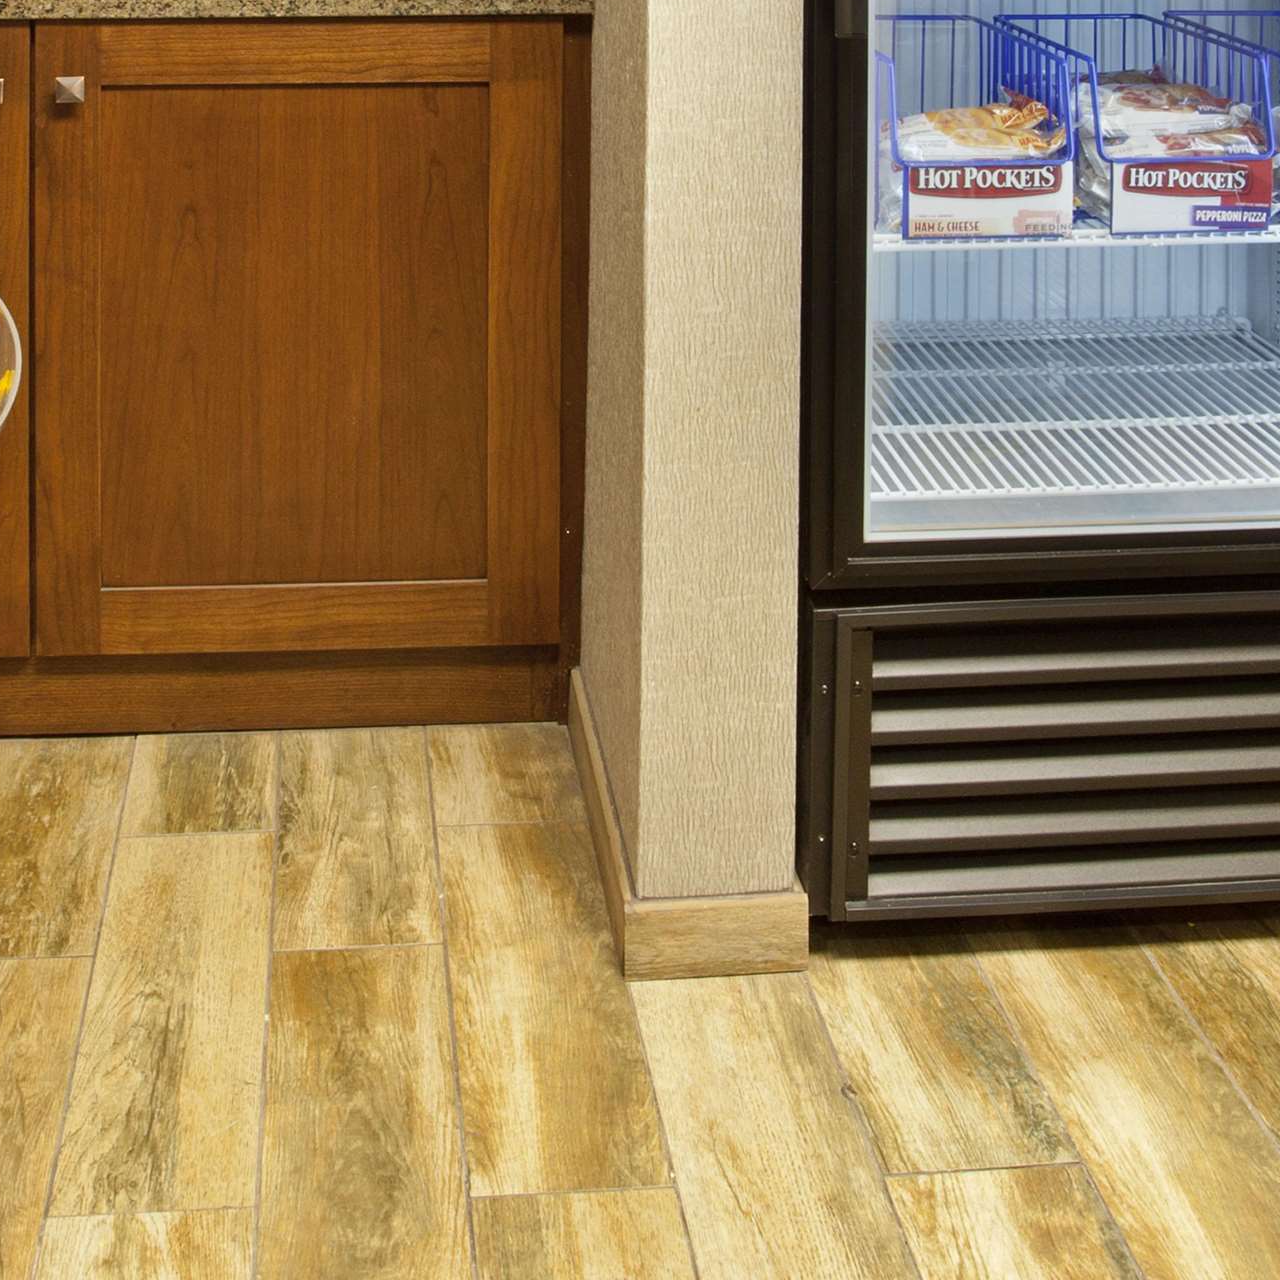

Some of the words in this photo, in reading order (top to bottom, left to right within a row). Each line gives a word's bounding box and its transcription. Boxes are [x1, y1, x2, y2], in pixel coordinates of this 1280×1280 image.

[918, 167, 962, 189] HOT
[964, 166, 1055, 190] POCKETS
[1130, 169, 1165, 188] HOT
[1168, 168, 1247, 189] POCKETS
[1196, 209, 1242, 223] PEPPERONI
[1243, 211, 1267, 223] PIZZA
[914, 223, 935, 233] HAM
[938, 222, 944, 232] &
[947, 222, 979, 231] CHEESE
